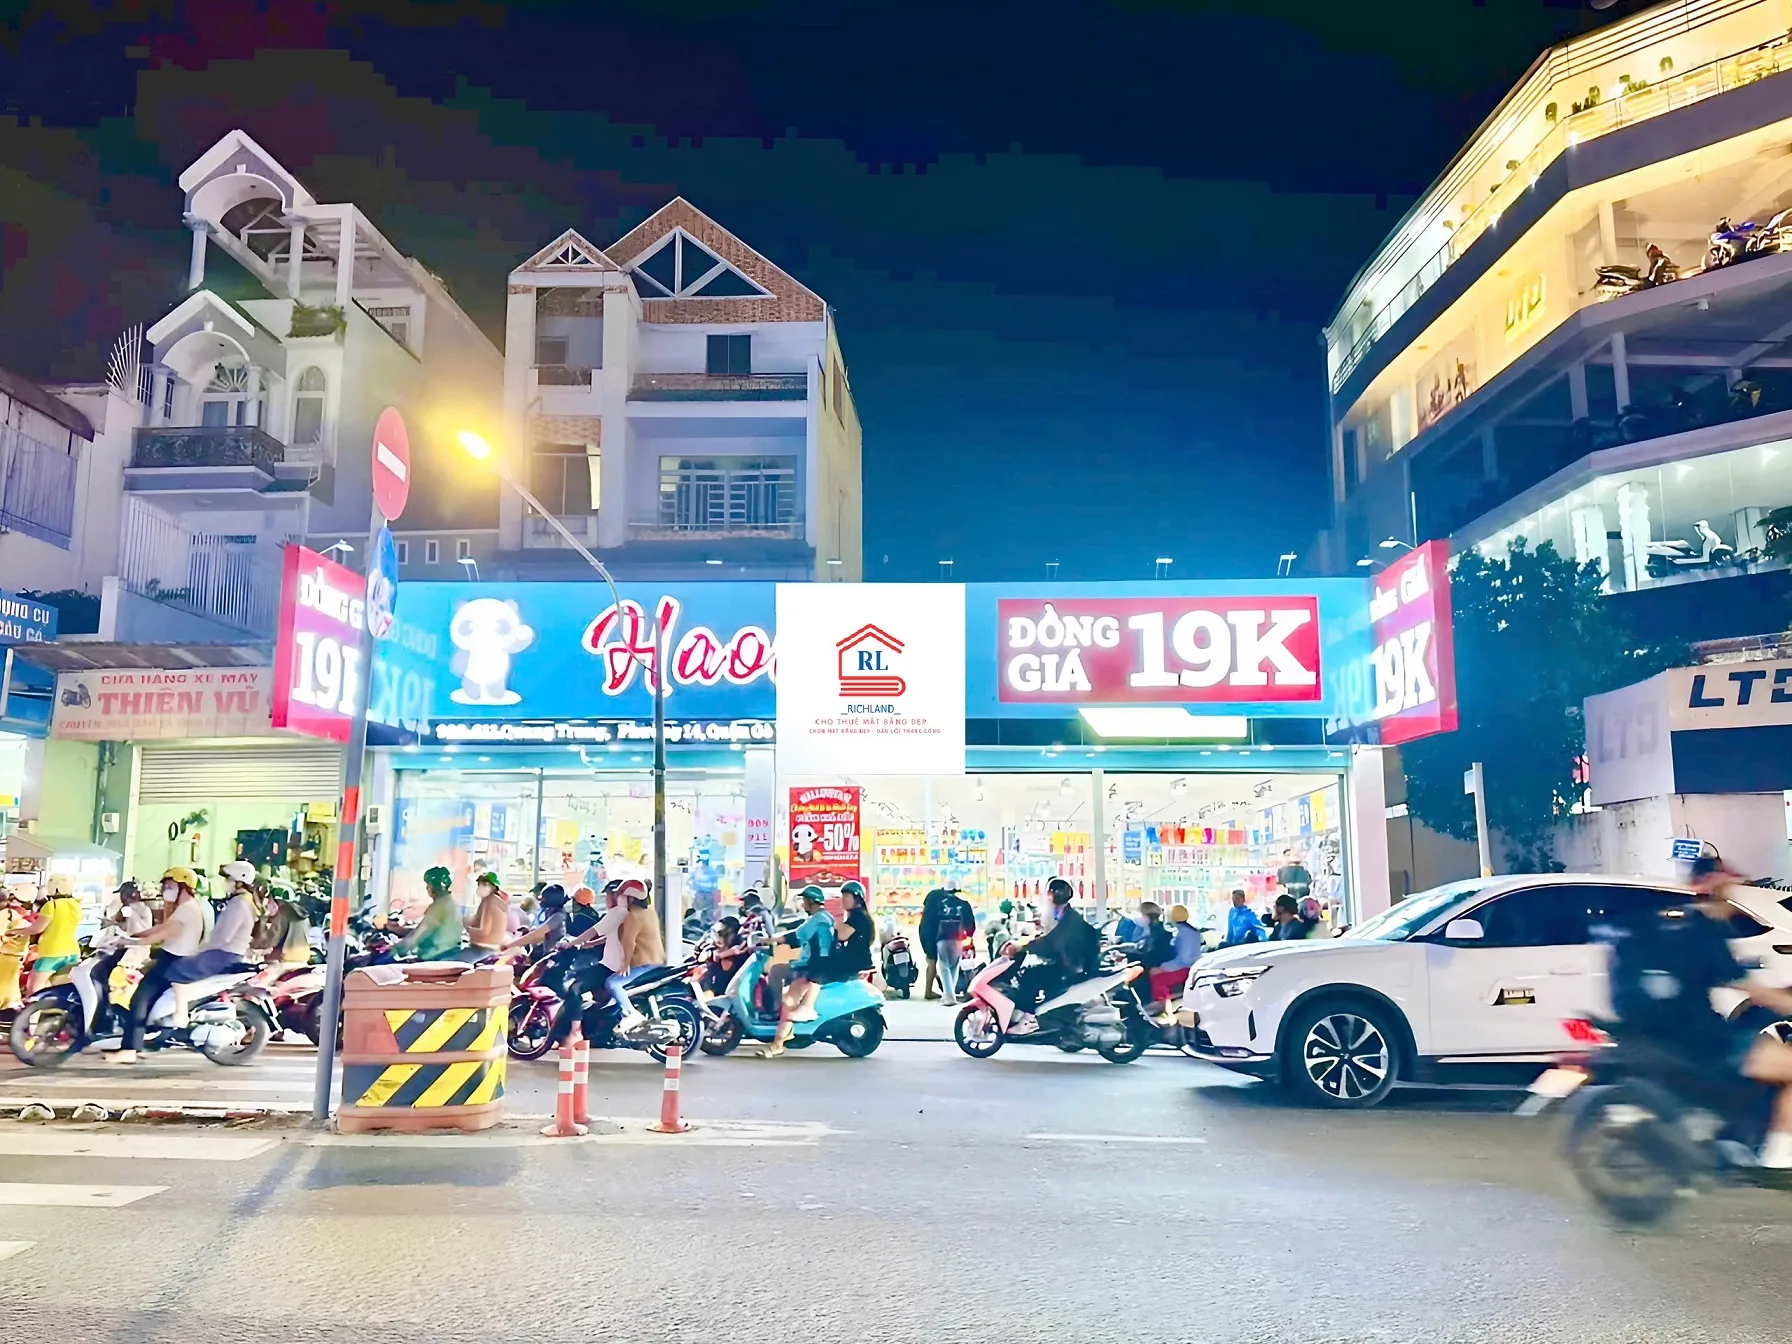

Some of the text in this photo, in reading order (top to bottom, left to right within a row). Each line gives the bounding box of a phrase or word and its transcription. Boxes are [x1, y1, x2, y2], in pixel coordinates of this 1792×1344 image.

[1007, 648, 1093, 692] GIÁ
[1127, 609, 1316, 688] 19K
[1369, 620, 1436, 721] 19K
[98, 687, 204, 714] THIÊN
